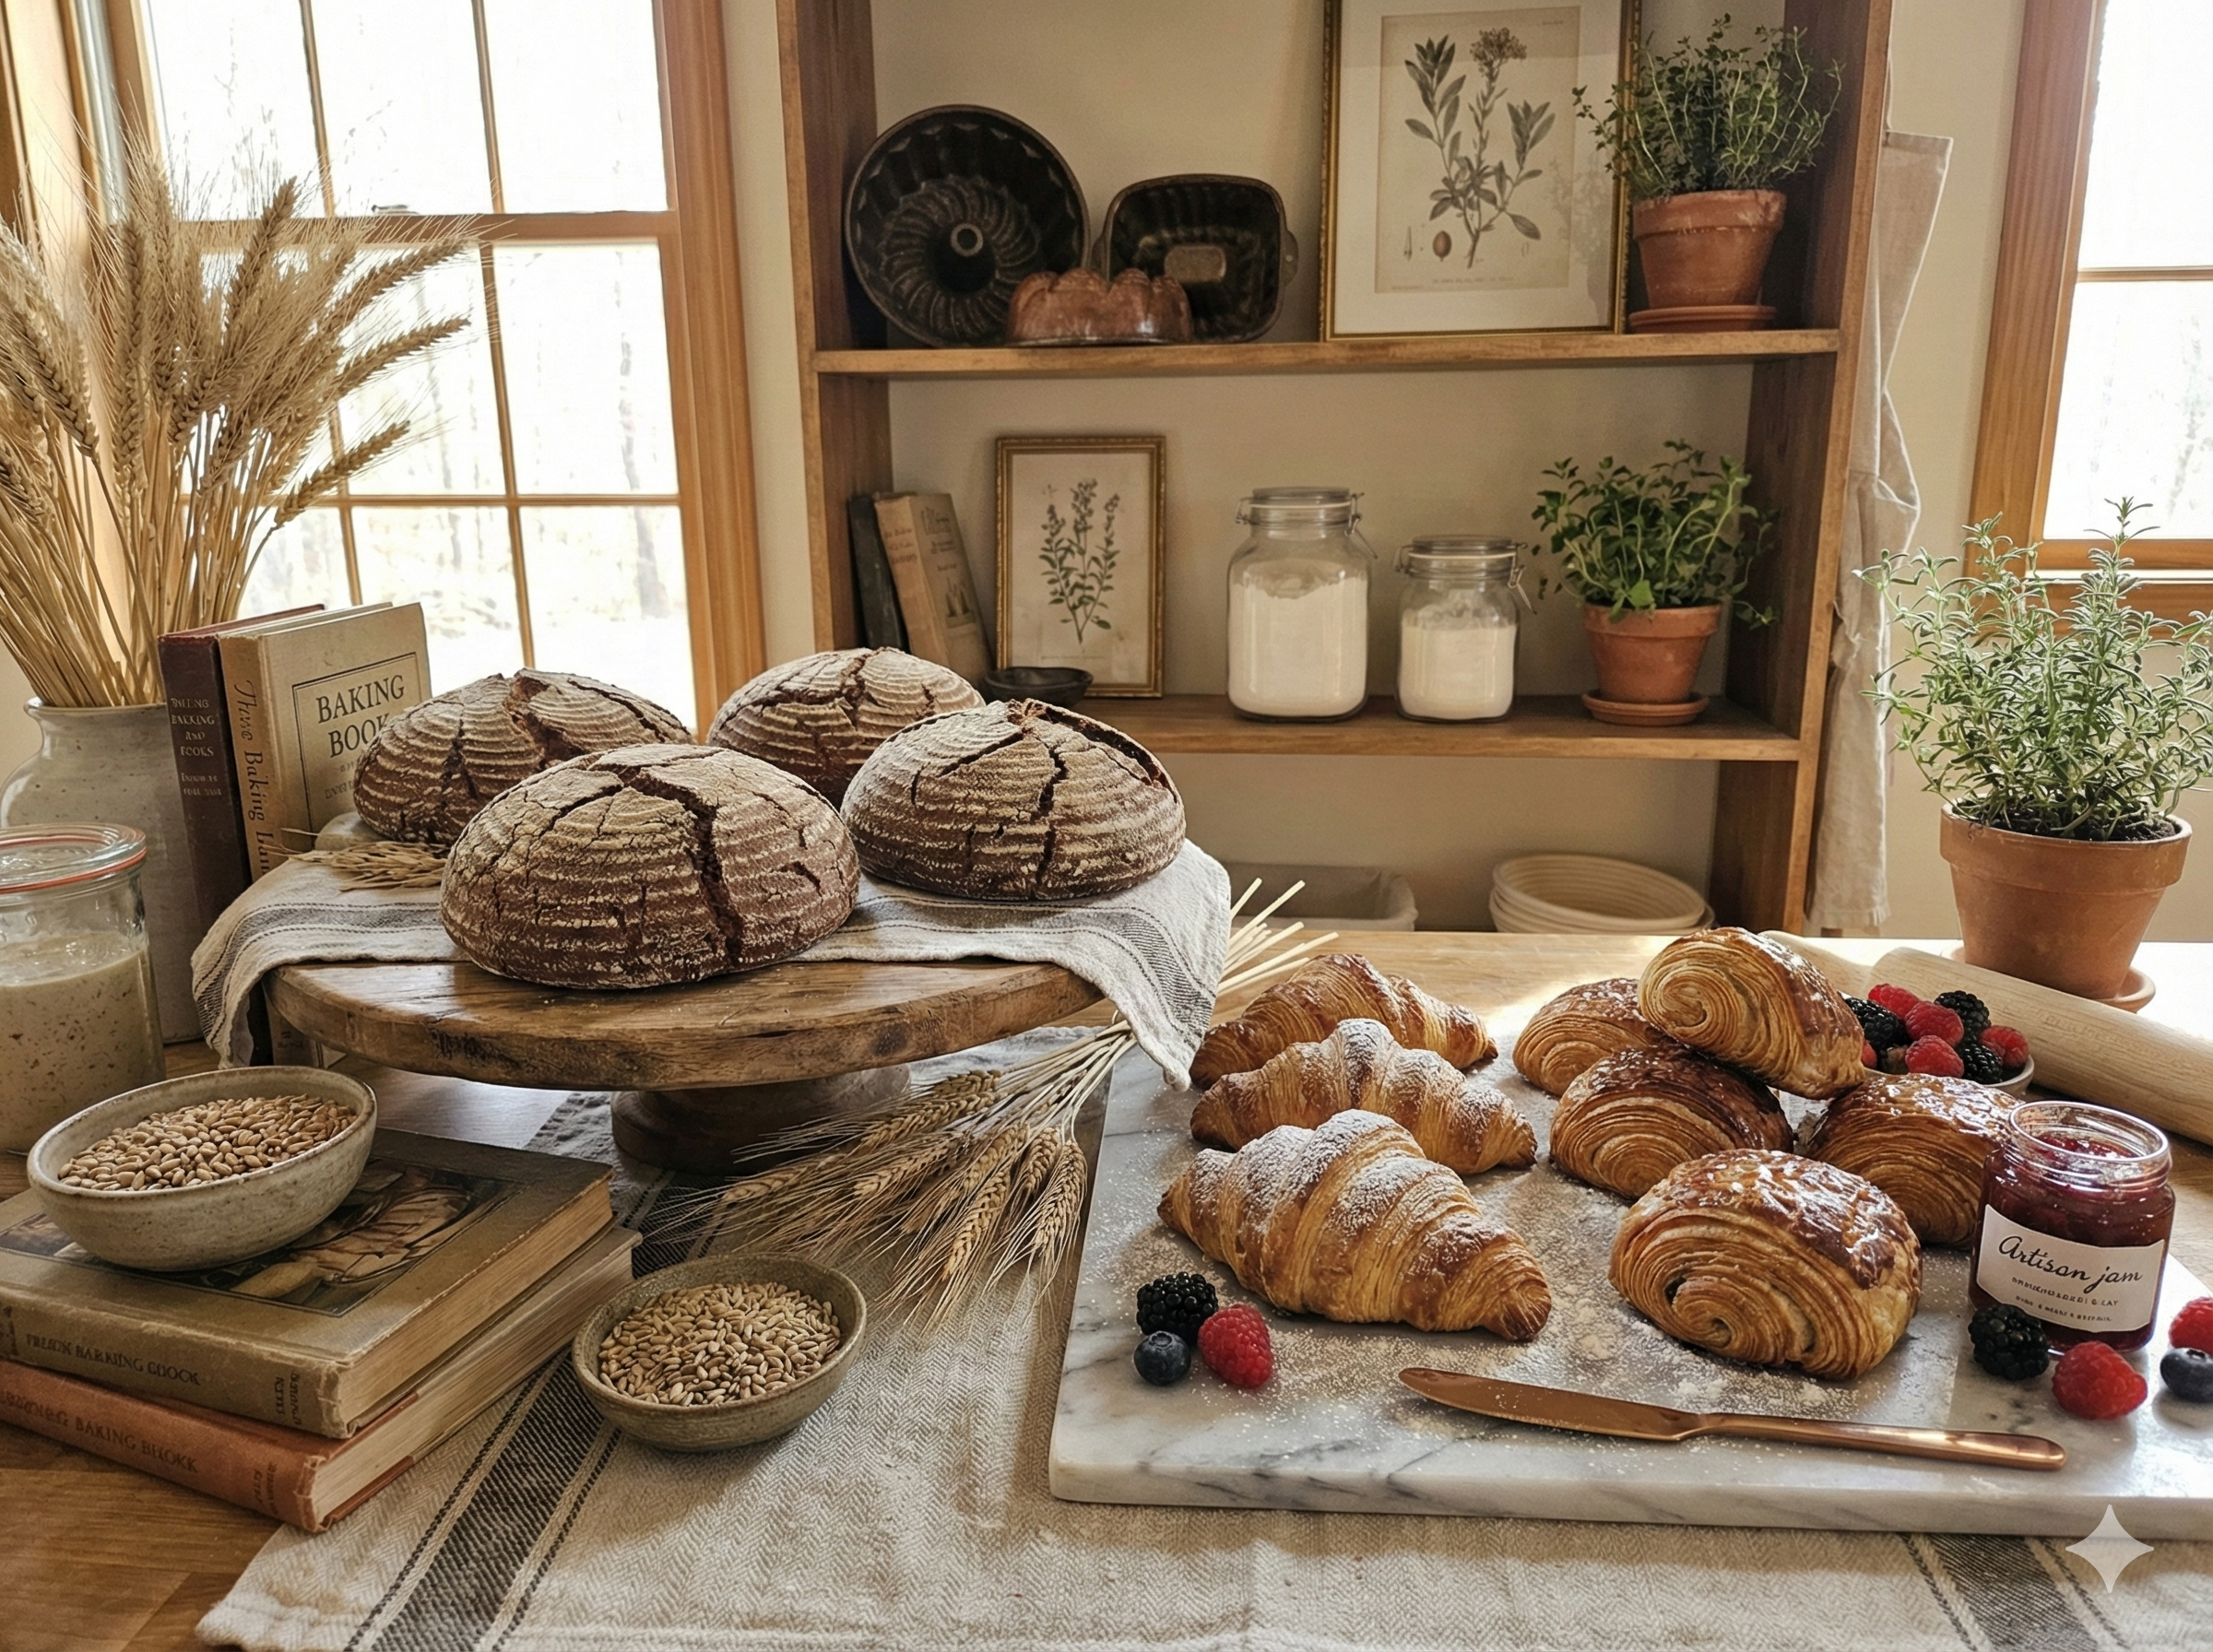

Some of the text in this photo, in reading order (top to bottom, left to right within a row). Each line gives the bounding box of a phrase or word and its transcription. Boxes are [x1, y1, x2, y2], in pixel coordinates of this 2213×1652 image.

[316, 675, 405, 724] BAKING
[244, 750, 269, 821] Baking
[2083, 1266, 2143, 1294] jam
[76, 1416, 136, 1450] BAKING
